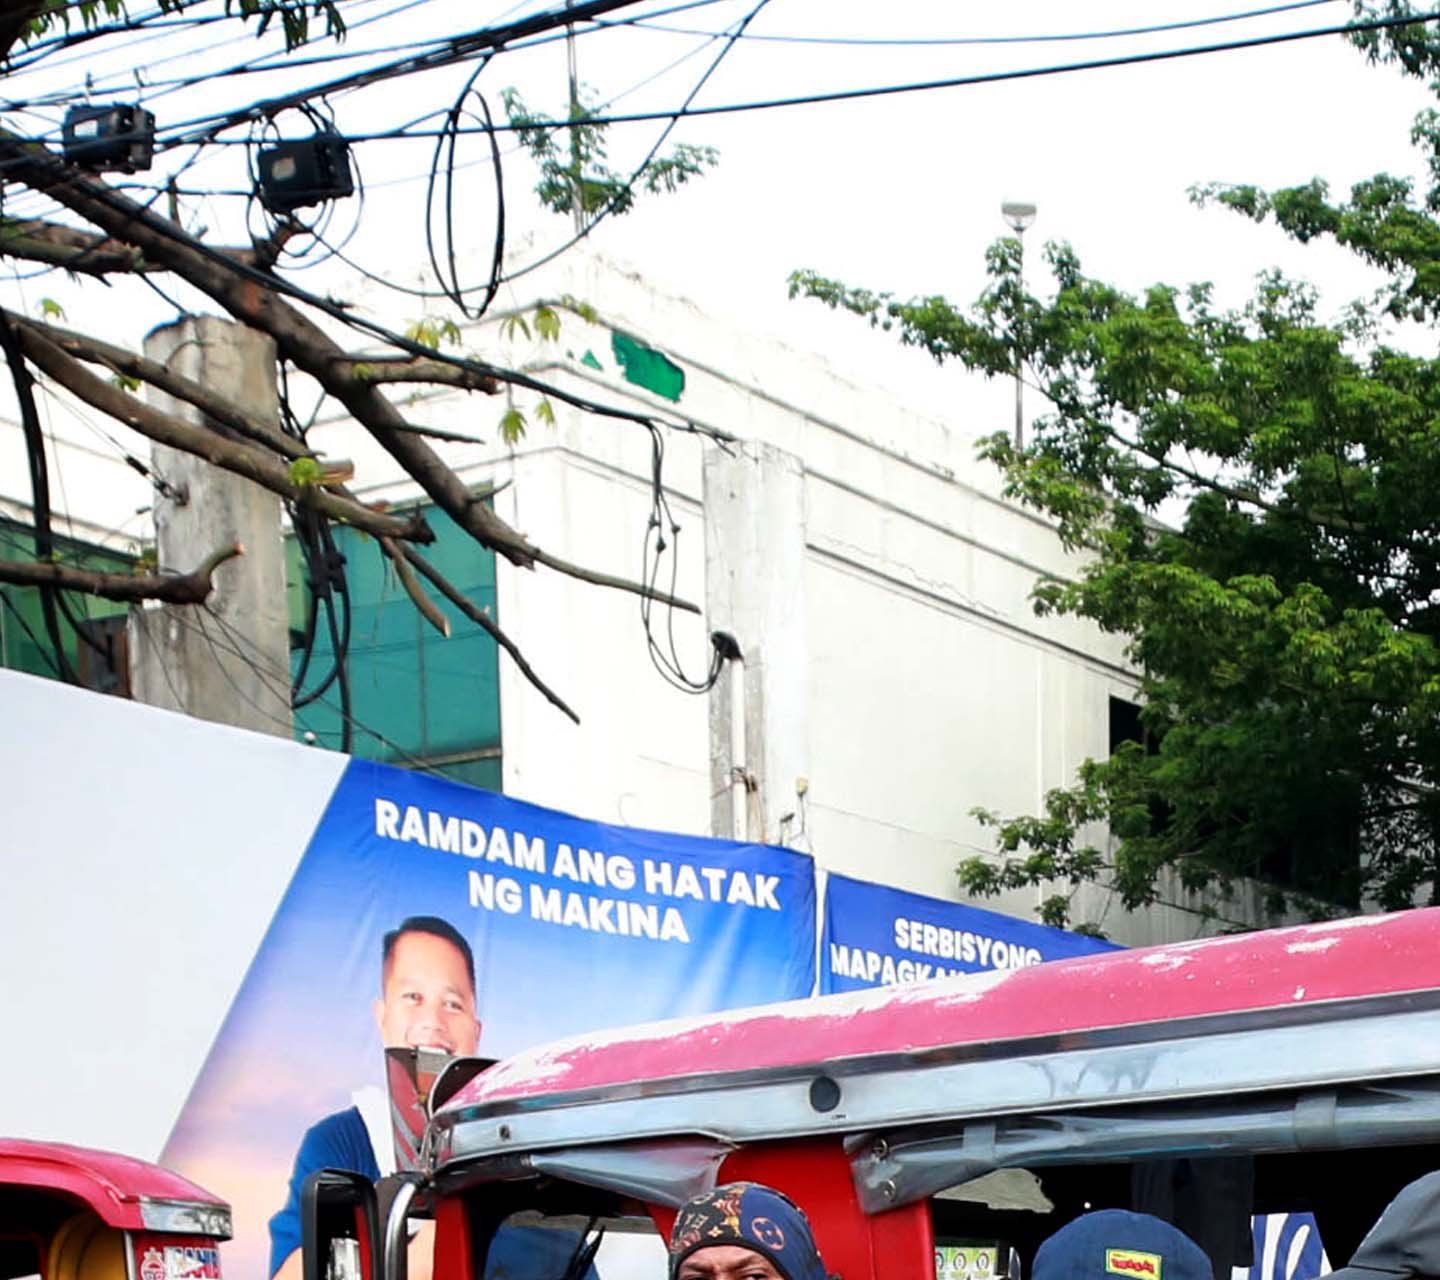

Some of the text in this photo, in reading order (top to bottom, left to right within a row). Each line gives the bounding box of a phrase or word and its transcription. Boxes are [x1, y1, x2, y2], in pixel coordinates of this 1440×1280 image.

[375, 798, 781, 911] RAMDAM ANG HATAK
[468, 870, 691, 944] NG MAKINA
[894, 917, 1043, 970] SERBISYONG
